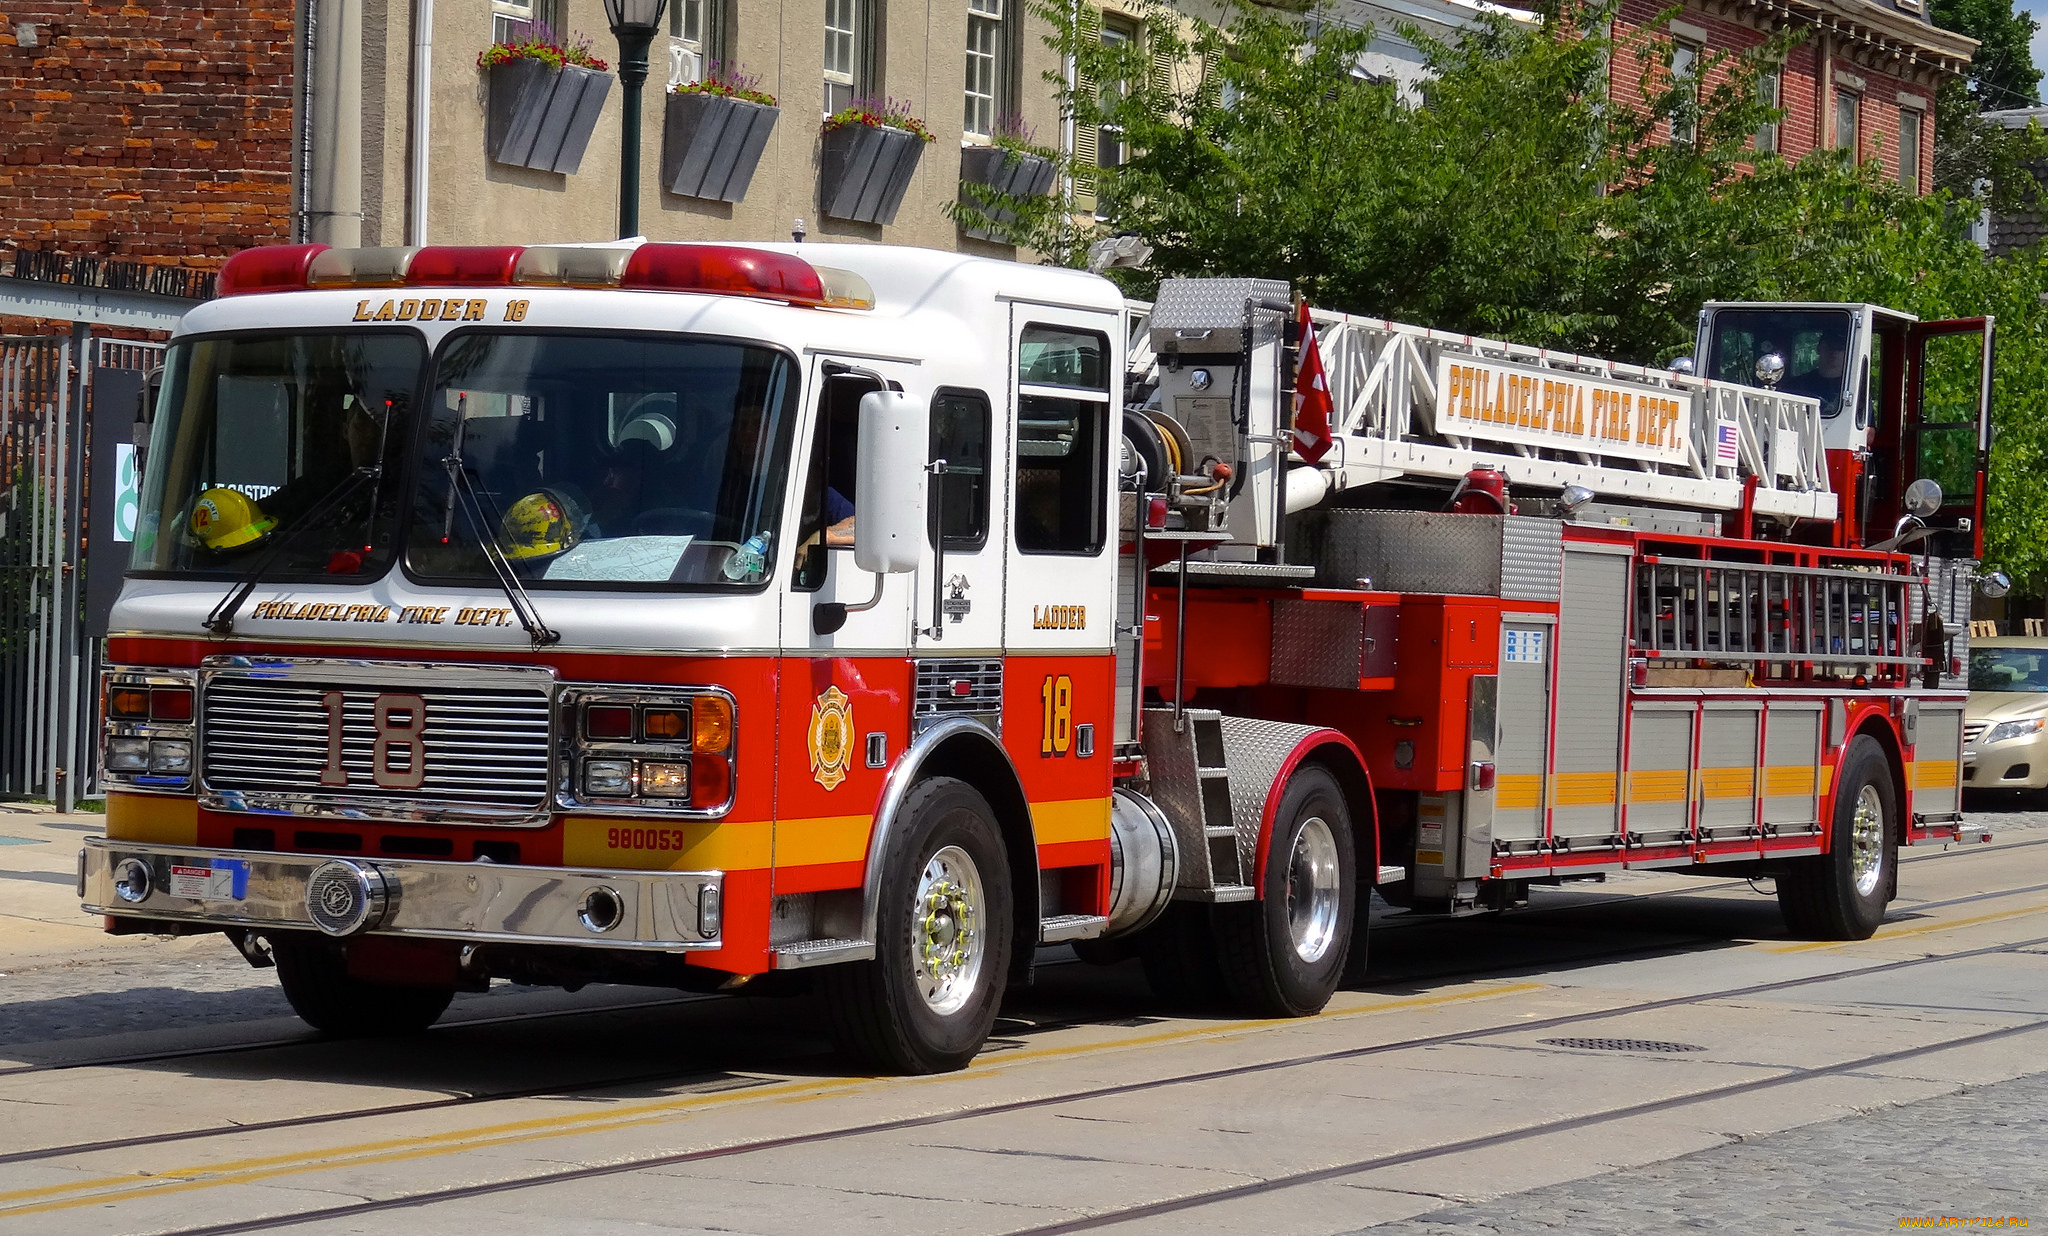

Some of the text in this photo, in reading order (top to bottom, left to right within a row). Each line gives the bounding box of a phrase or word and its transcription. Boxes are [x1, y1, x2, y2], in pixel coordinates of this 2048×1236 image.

[352, 298, 530, 322] LADDER 18
[1447, 364, 1682, 450] PHILADELPHIA FIRE DEPT.
[193, 508, 208, 528] 12
[252, 601, 513, 627] PHILADELPHIA FIRE DEPT.
[1033, 604, 1087, 630] LADDER
[1040, 675, 1074, 758] 18
[321, 690, 427, 789] 18
[607, 827, 684, 851] 980053
